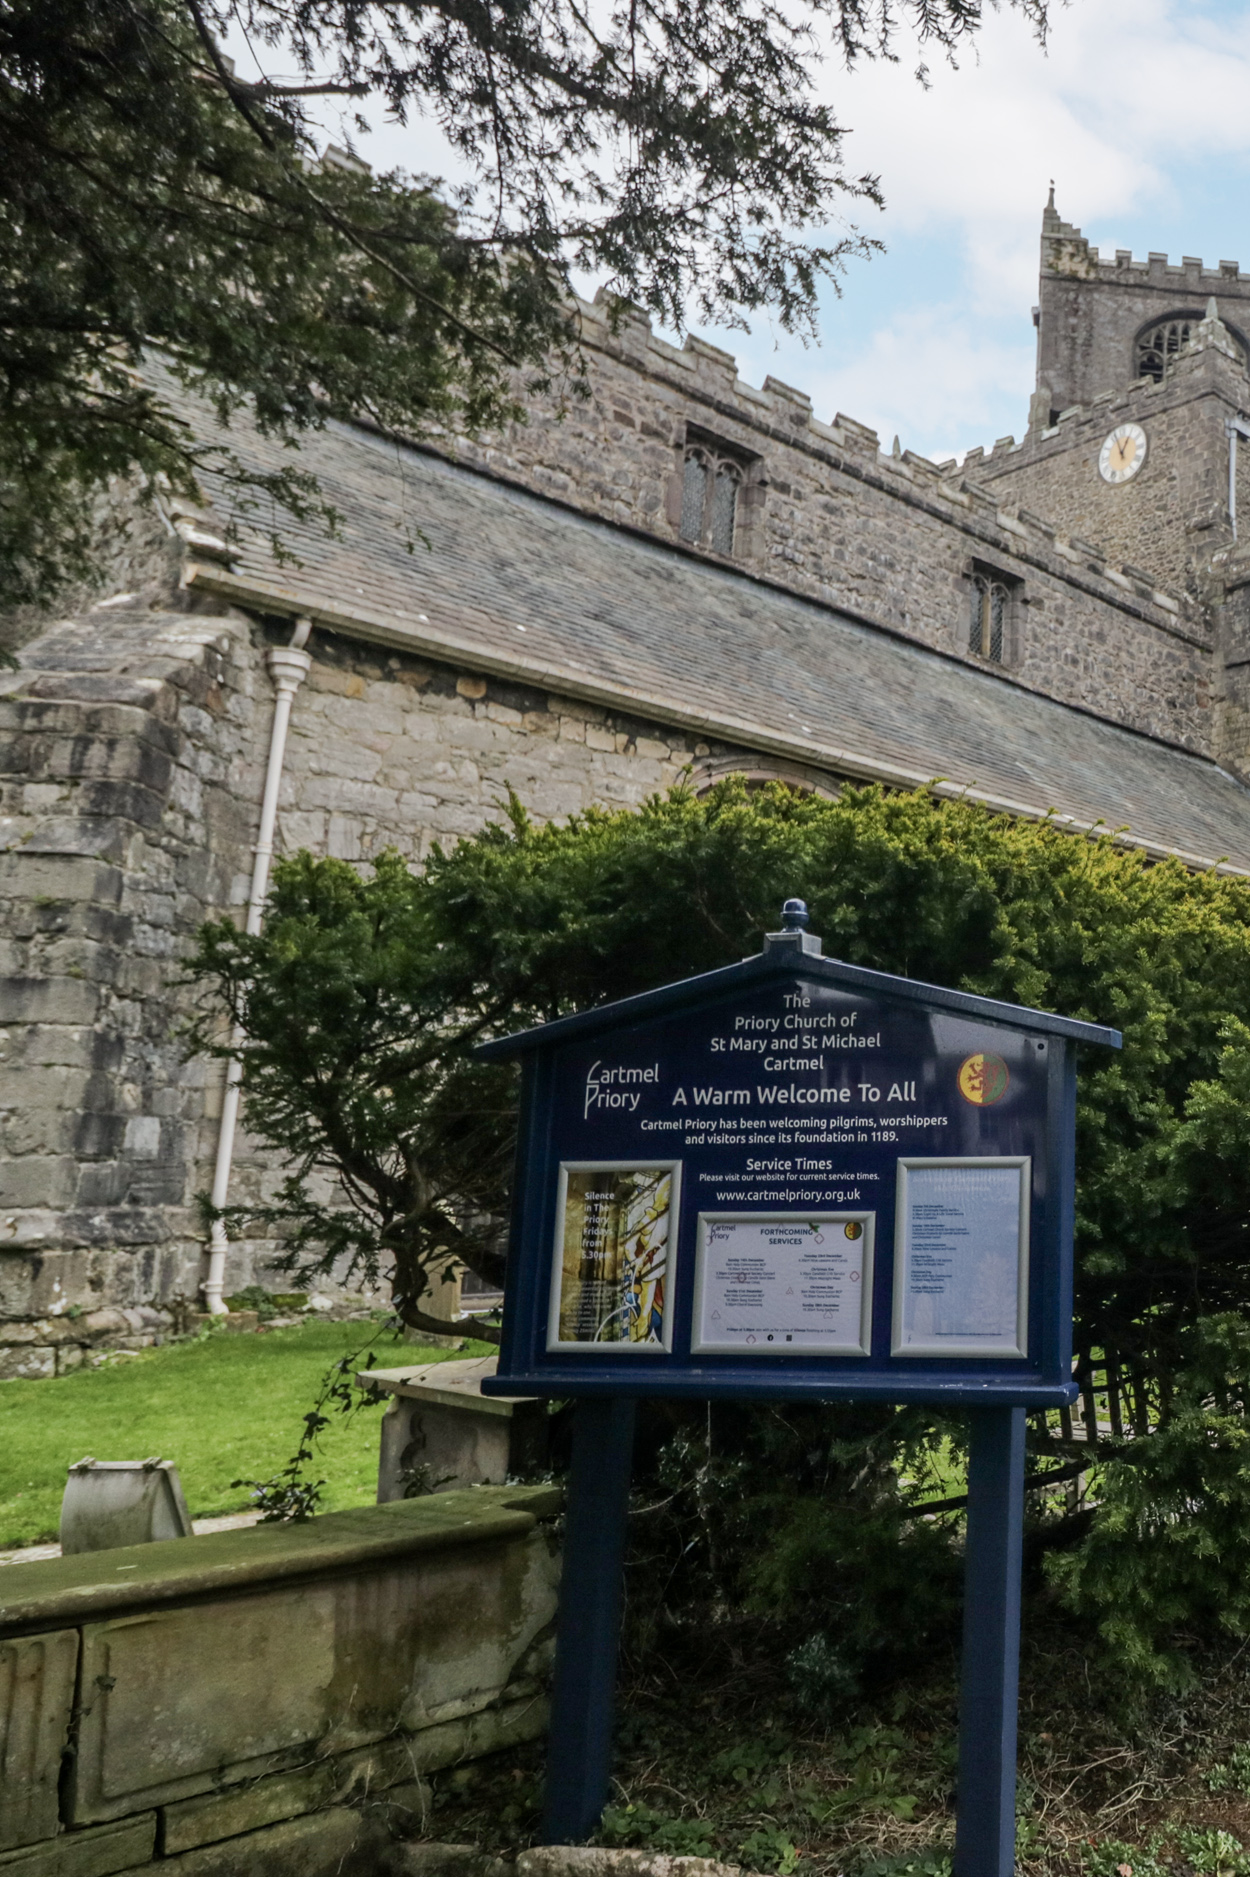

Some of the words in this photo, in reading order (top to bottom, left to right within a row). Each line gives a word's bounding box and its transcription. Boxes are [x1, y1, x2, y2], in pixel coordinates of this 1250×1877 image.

[784, 994, 811, 1008] The
[735, 1016, 780, 1032] Priory
[784, 1013, 835, 1028] Church
[841, 1012, 857, 1027] of
[711, 1038, 725, 1051] St
[730, 1038, 767, 1053] Mary
[771, 1035, 798, 1049] and
[803, 1035, 817, 1049] St
[822, 1033, 880, 1048] Michael
[764, 1055, 823, 1070] Cartmel
[587, 1061, 658, 1083] Cartmel
[672, 1088, 687, 1105] A
[693, 1087, 750, 1105] Warm
[757, 1084, 850, 1103] Welcome
[858, 1084, 880, 1102] To
[887, 1081, 916, 1101] All
[584, 1085, 640, 1119] Priory
[641, 1119, 682, 1130] Cartmel
[685, 1119, 717, 1131] Priory
[720, 1118, 737, 1129] has
[740, 1118, 766, 1128] been
[769, 1117, 827, 1129] welcoming
[830, 1116, 876, 1129] pilgrims,
[880, 1115, 947, 1127] worshippers
[685, 1133, 704, 1144] and
[707, 1133, 746, 1144] visitors
[749, 1133, 775, 1143] since
[779, 1133, 791, 1143] its
[795, 1132, 854, 1142] foundation
[858, 1131, 867, 1141] in
[872, 1131, 898, 1141] 1189.
[747, 1158, 791, 1170] Service
[795, 1158, 832, 1169] Times
[756, 1173, 785, 1181] website
[787, 1172, 798, 1180] for
[829, 1172, 855, 1180] service
[857, 1172, 879, 1180] times.
[585, 1192, 614, 1200] Silence
[717, 1188, 860, 1202] www.cartmelpriory.org.uk
[584, 1204, 592, 1212] in
[584, 1215, 610, 1226] Priory
[711, 1223, 736, 1231] Cartmel
[583, 1227, 613, 1237] Fridays
[711, 1230, 729, 1243] Priory
[760, 1228, 813, 1236] FORTHCOMING
[582, 1239, 603, 1248] from
